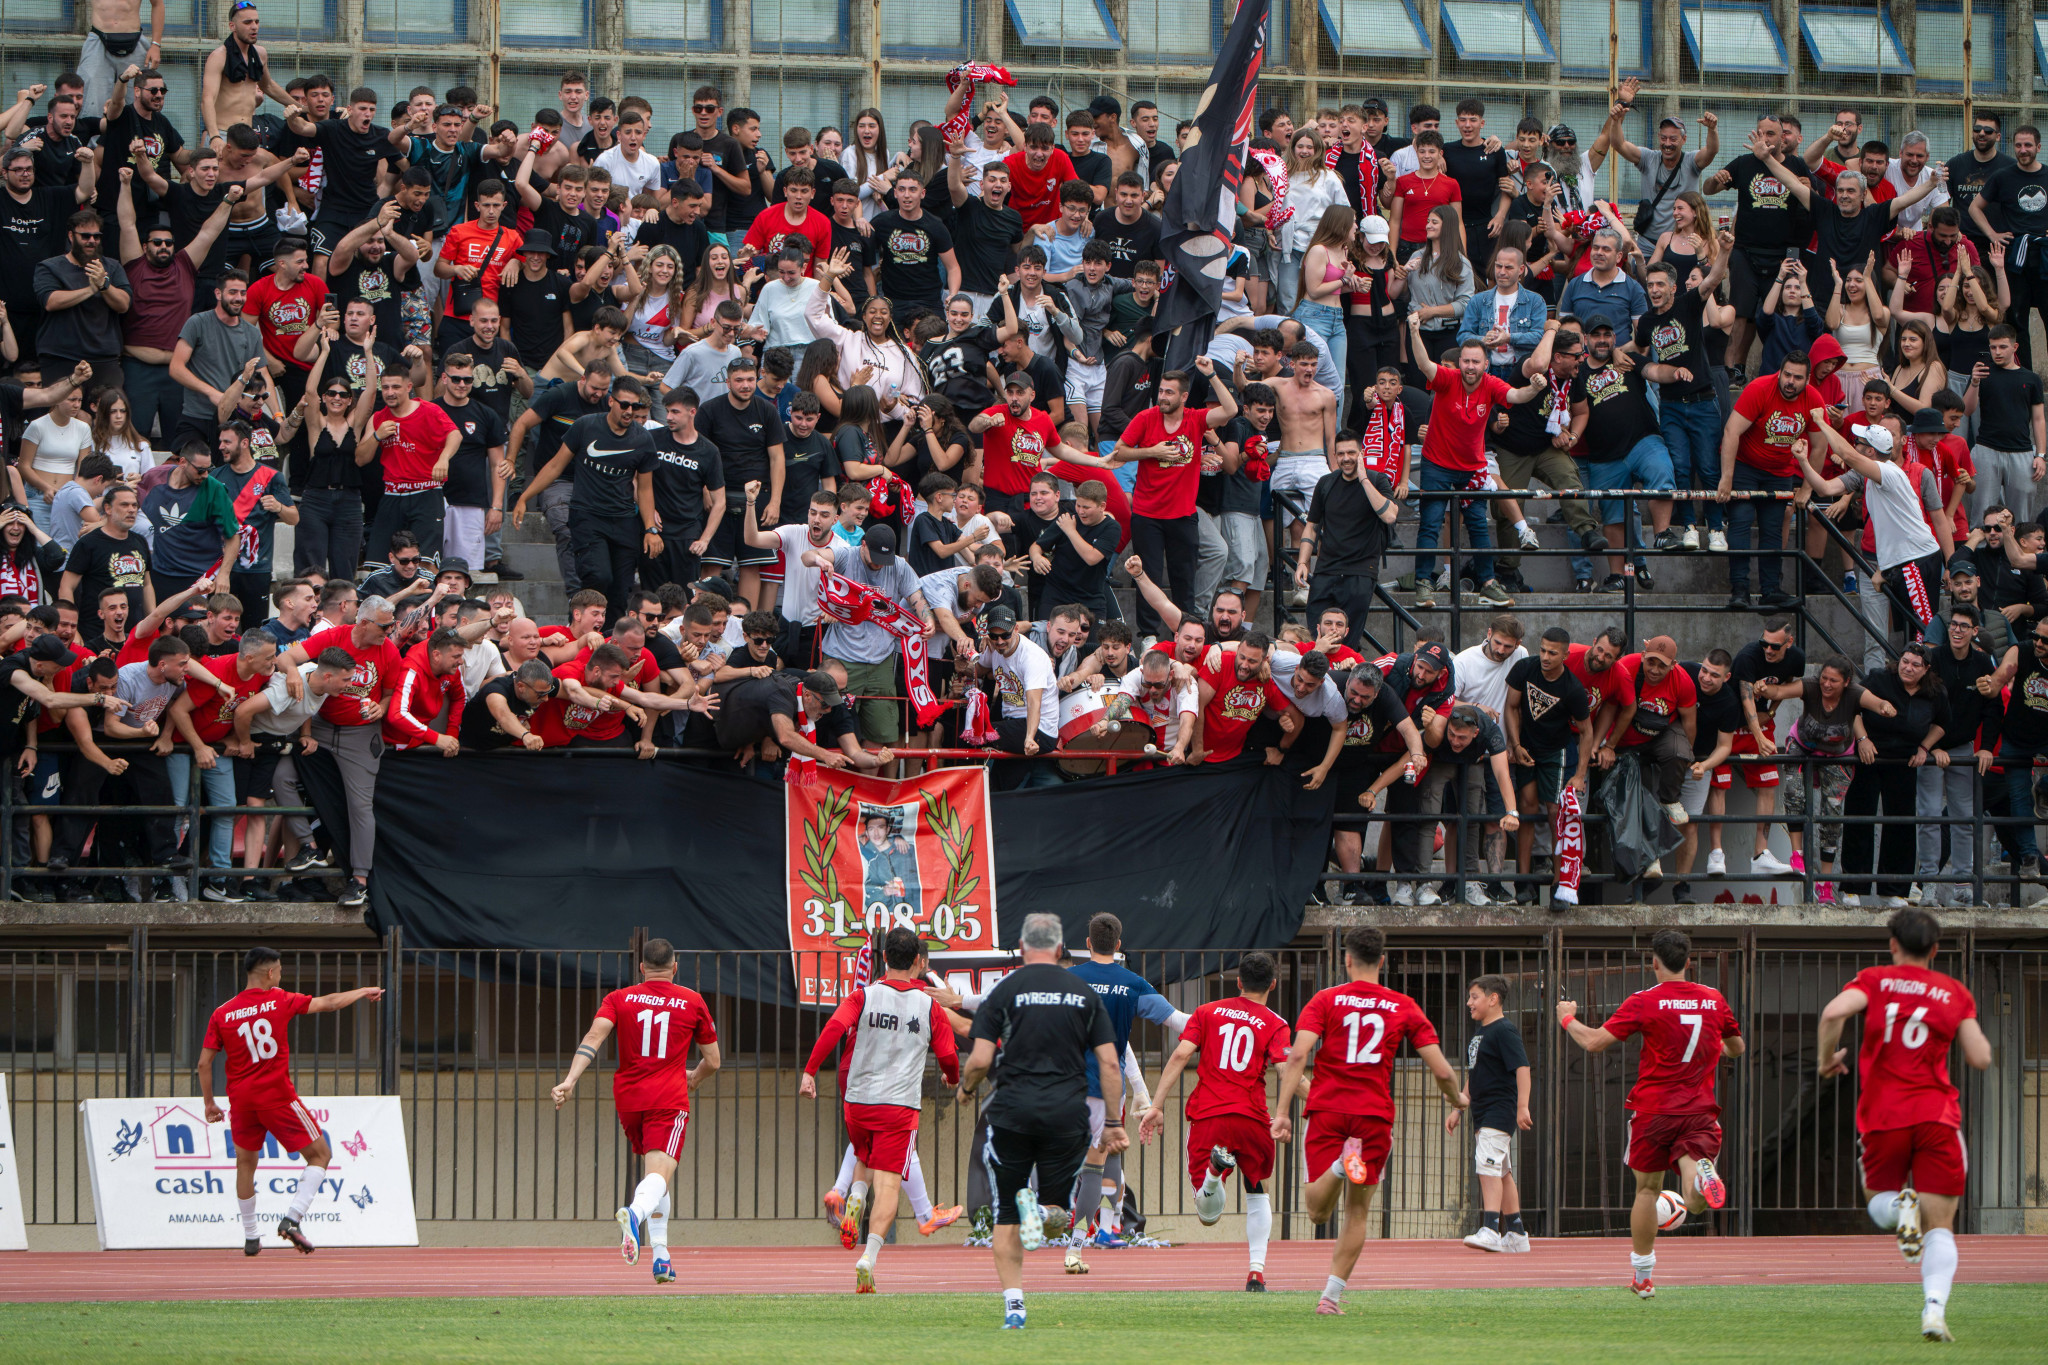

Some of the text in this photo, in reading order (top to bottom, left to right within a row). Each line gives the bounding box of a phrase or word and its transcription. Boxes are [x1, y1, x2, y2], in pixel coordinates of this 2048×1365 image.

[656, 450, 699, 471] adidas
[625, 994, 688, 1010] PYRGOS AFC
[1015, 992, 1087, 1008] PYRGOS AFC
[1111, 985, 1130, 997] AFC
[1880, 978, 1952, 1004] PYRGOS AFC
[225, 1000, 278, 1023] PYRGOS AFC
[1334, 995, 1400, 1013] PYRGOS AFC
[1658, 999, 1717, 1011] PYRGOS AFC
[869, 1012, 899, 1031] LIGA
[1213, 1007, 1266, 1030] PYRGOS AFC
[1884, 1002, 1930, 1049] 16
[237, 1018, 278, 1064] 18
[637, 1009, 671, 1059] 11
[1342, 1011, 1385, 1064] 12
[1680, 1014, 1703, 1063] 7
[1218, 1022, 1255, 1073] 10
[155, 1170, 344, 1202] cash cary
[168, 1213, 225, 1223] ΑΜΑΛΙΑΔΑ
